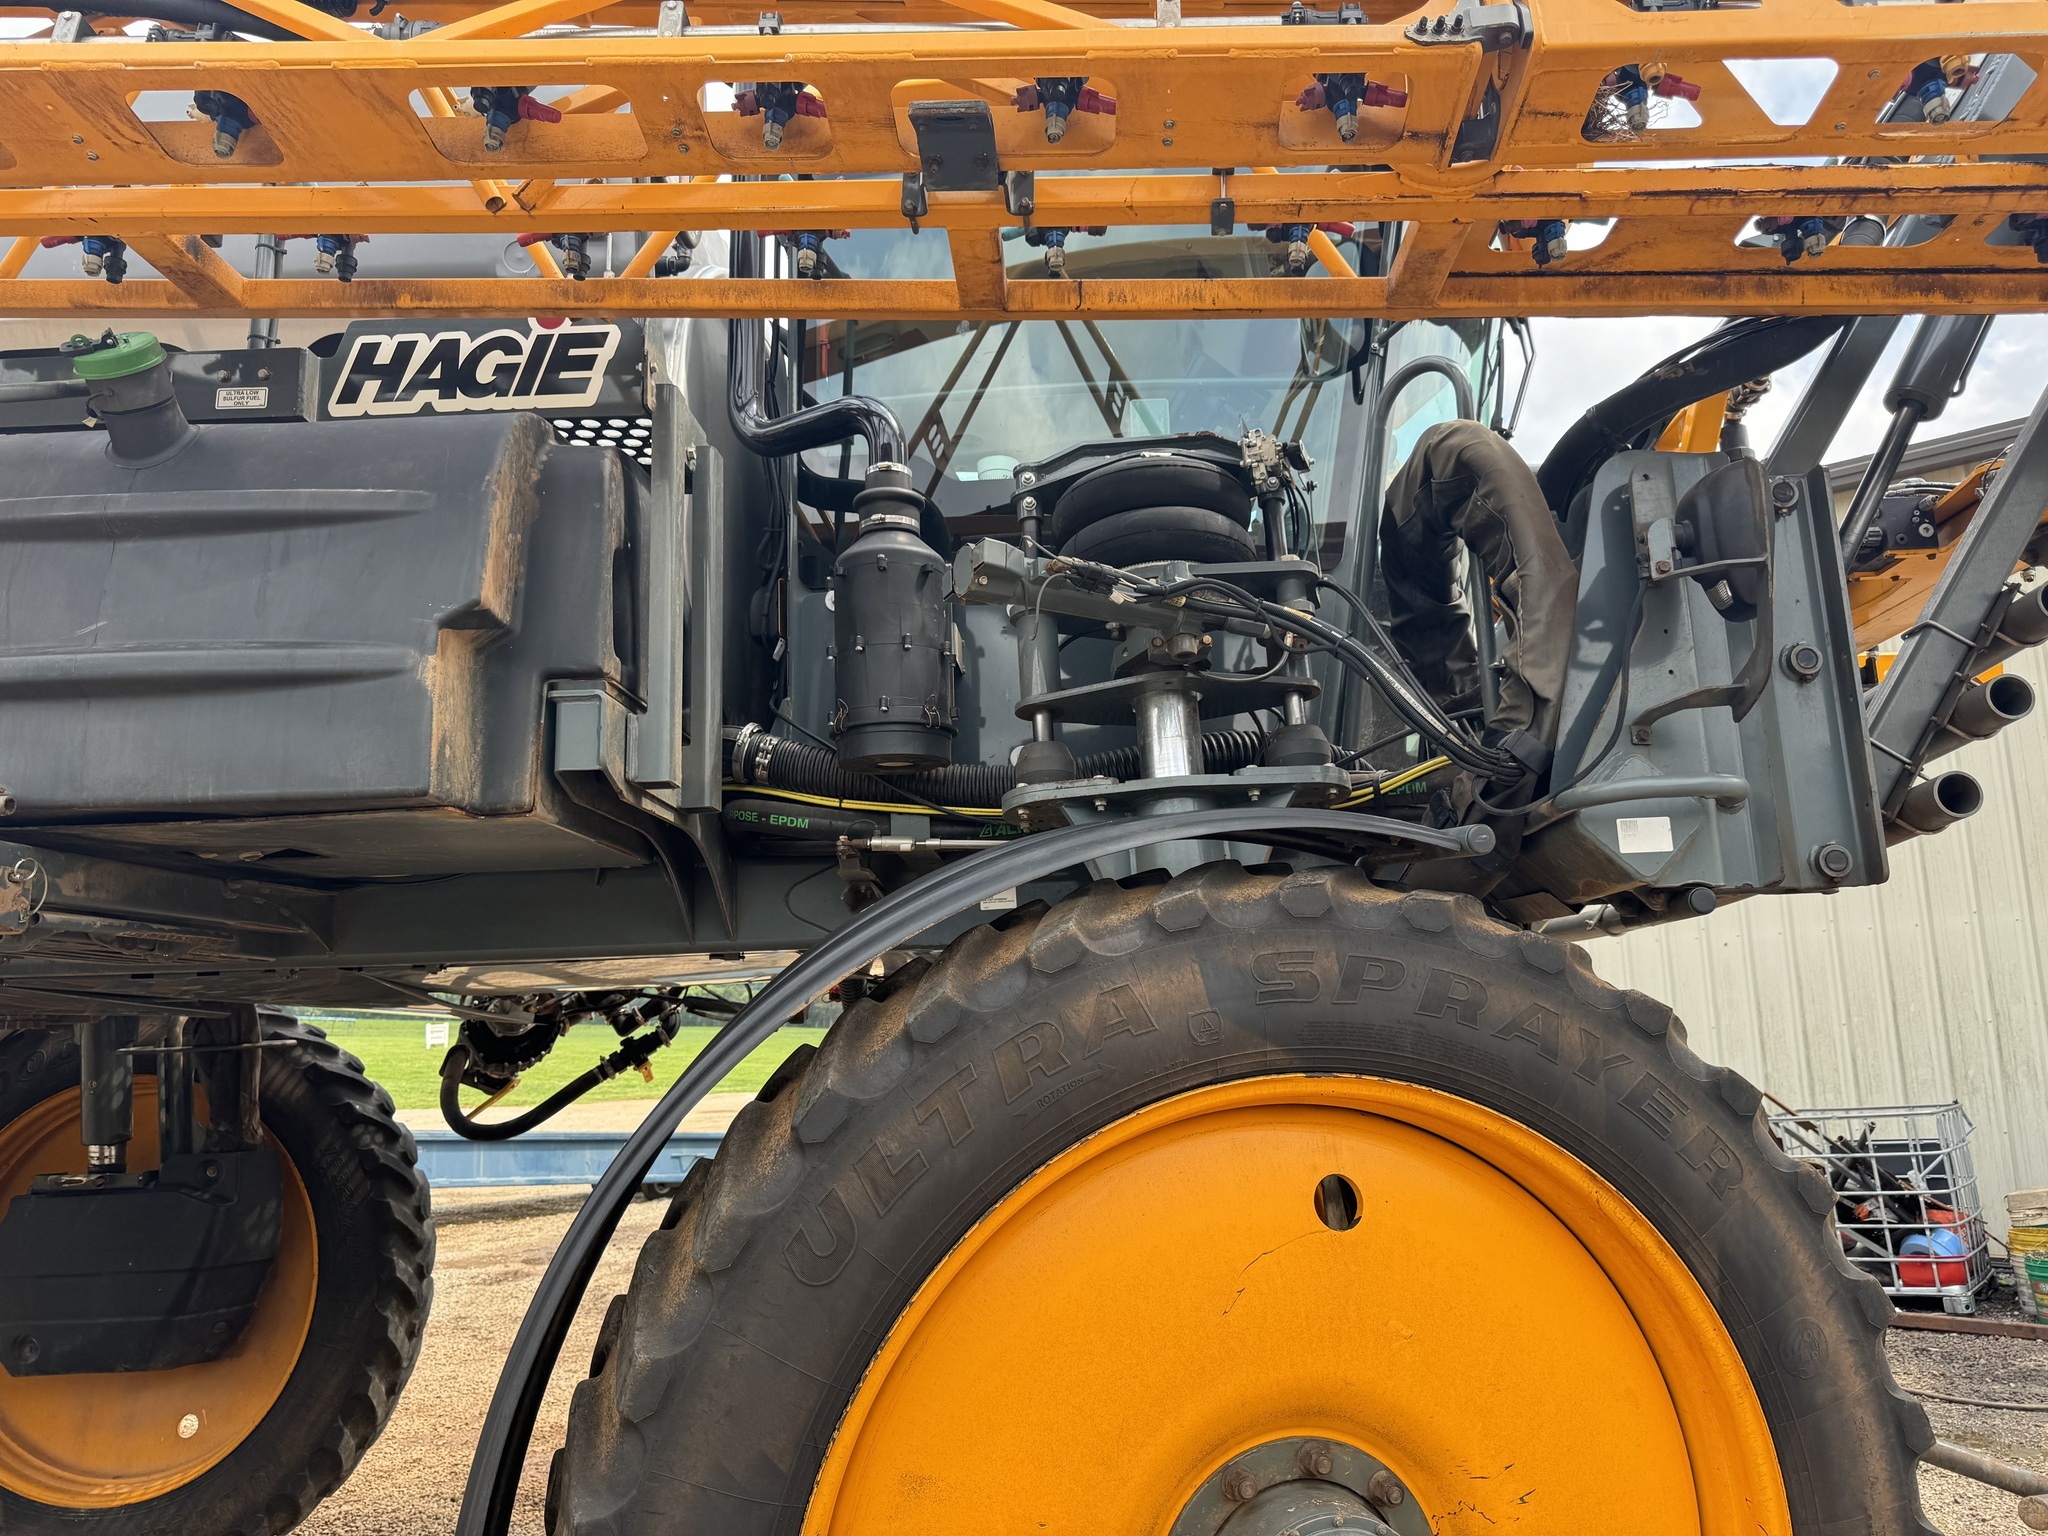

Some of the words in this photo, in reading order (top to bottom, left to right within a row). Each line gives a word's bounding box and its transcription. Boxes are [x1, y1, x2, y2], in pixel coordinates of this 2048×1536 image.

[333, 322, 612, 407] HAGIE
[769, 814, 810, 829] EPDM
[783, 982, 1158, 1287] ULTRA
[1250, 950, 1744, 1201] SPRAYER
[1036, 1076, 1086, 1109] ROTATION
